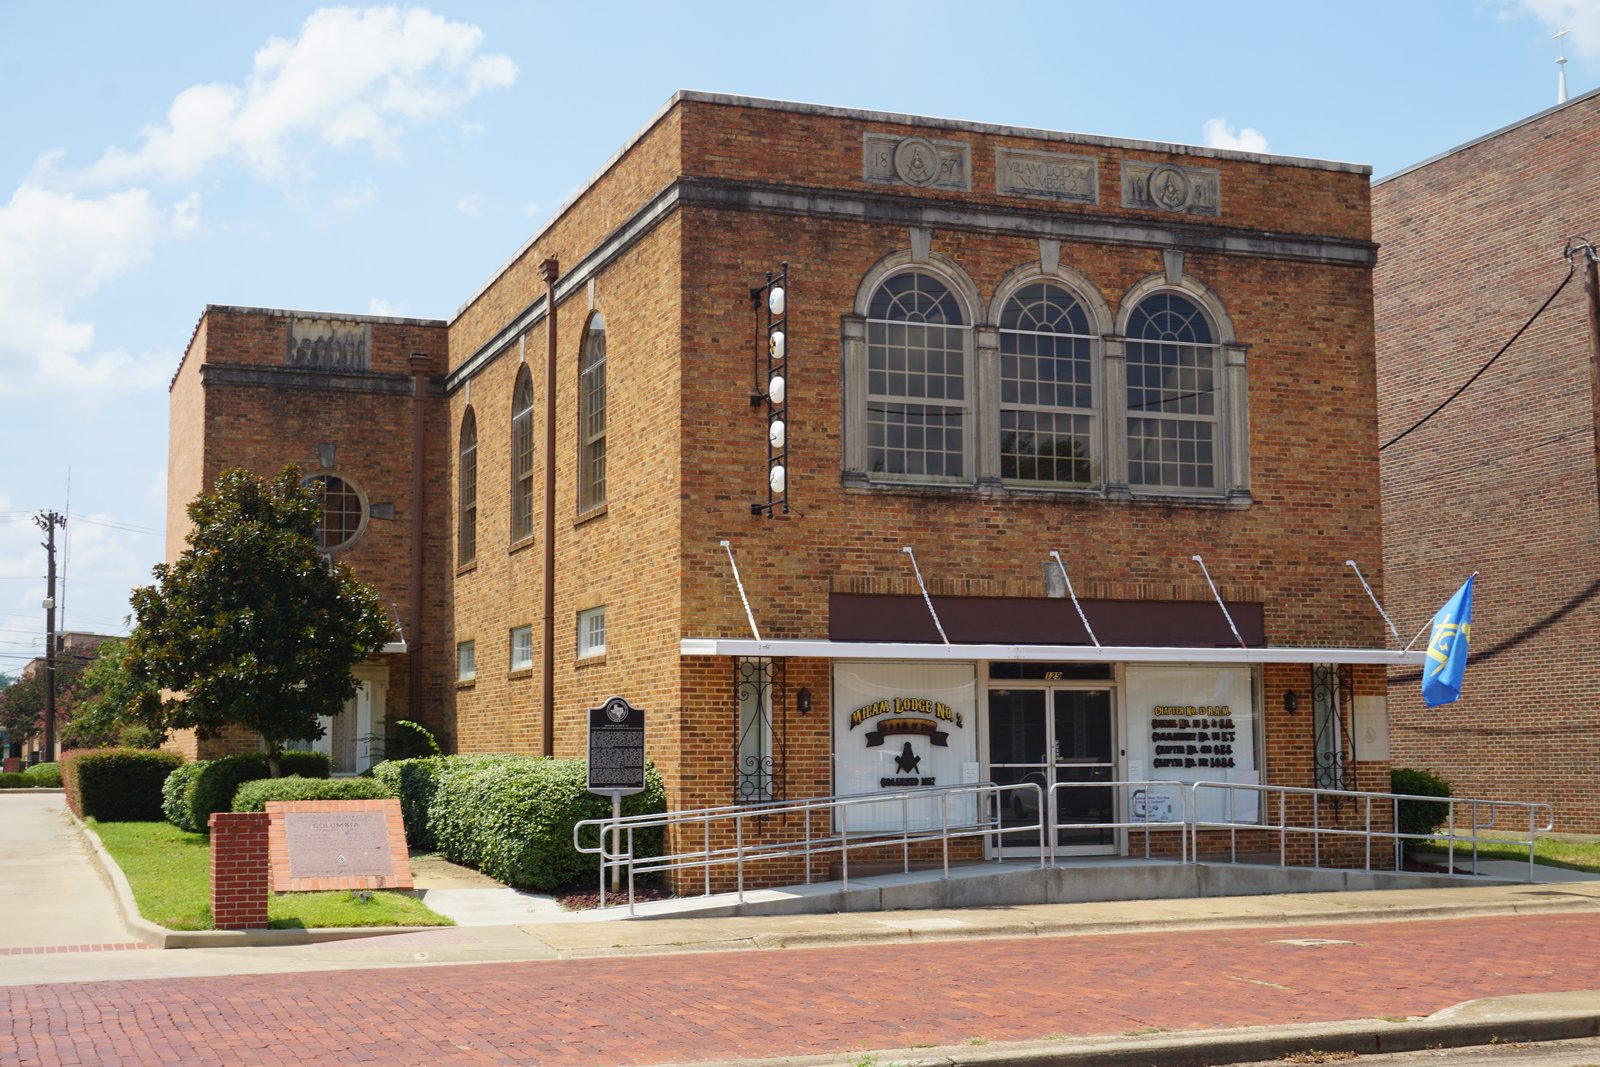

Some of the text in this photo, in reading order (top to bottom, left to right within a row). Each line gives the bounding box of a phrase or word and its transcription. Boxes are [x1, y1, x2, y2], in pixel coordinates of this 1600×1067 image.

[874, 151, 958, 175] 18 37
[1017, 174, 1078, 192] NUMBER 2
[849, 700, 890, 730] MILAM
[894, 697, 932, 714] LODGE
[955, 712, 964, 729] 2
[1154, 705, 1185, 717] CHAPTER
